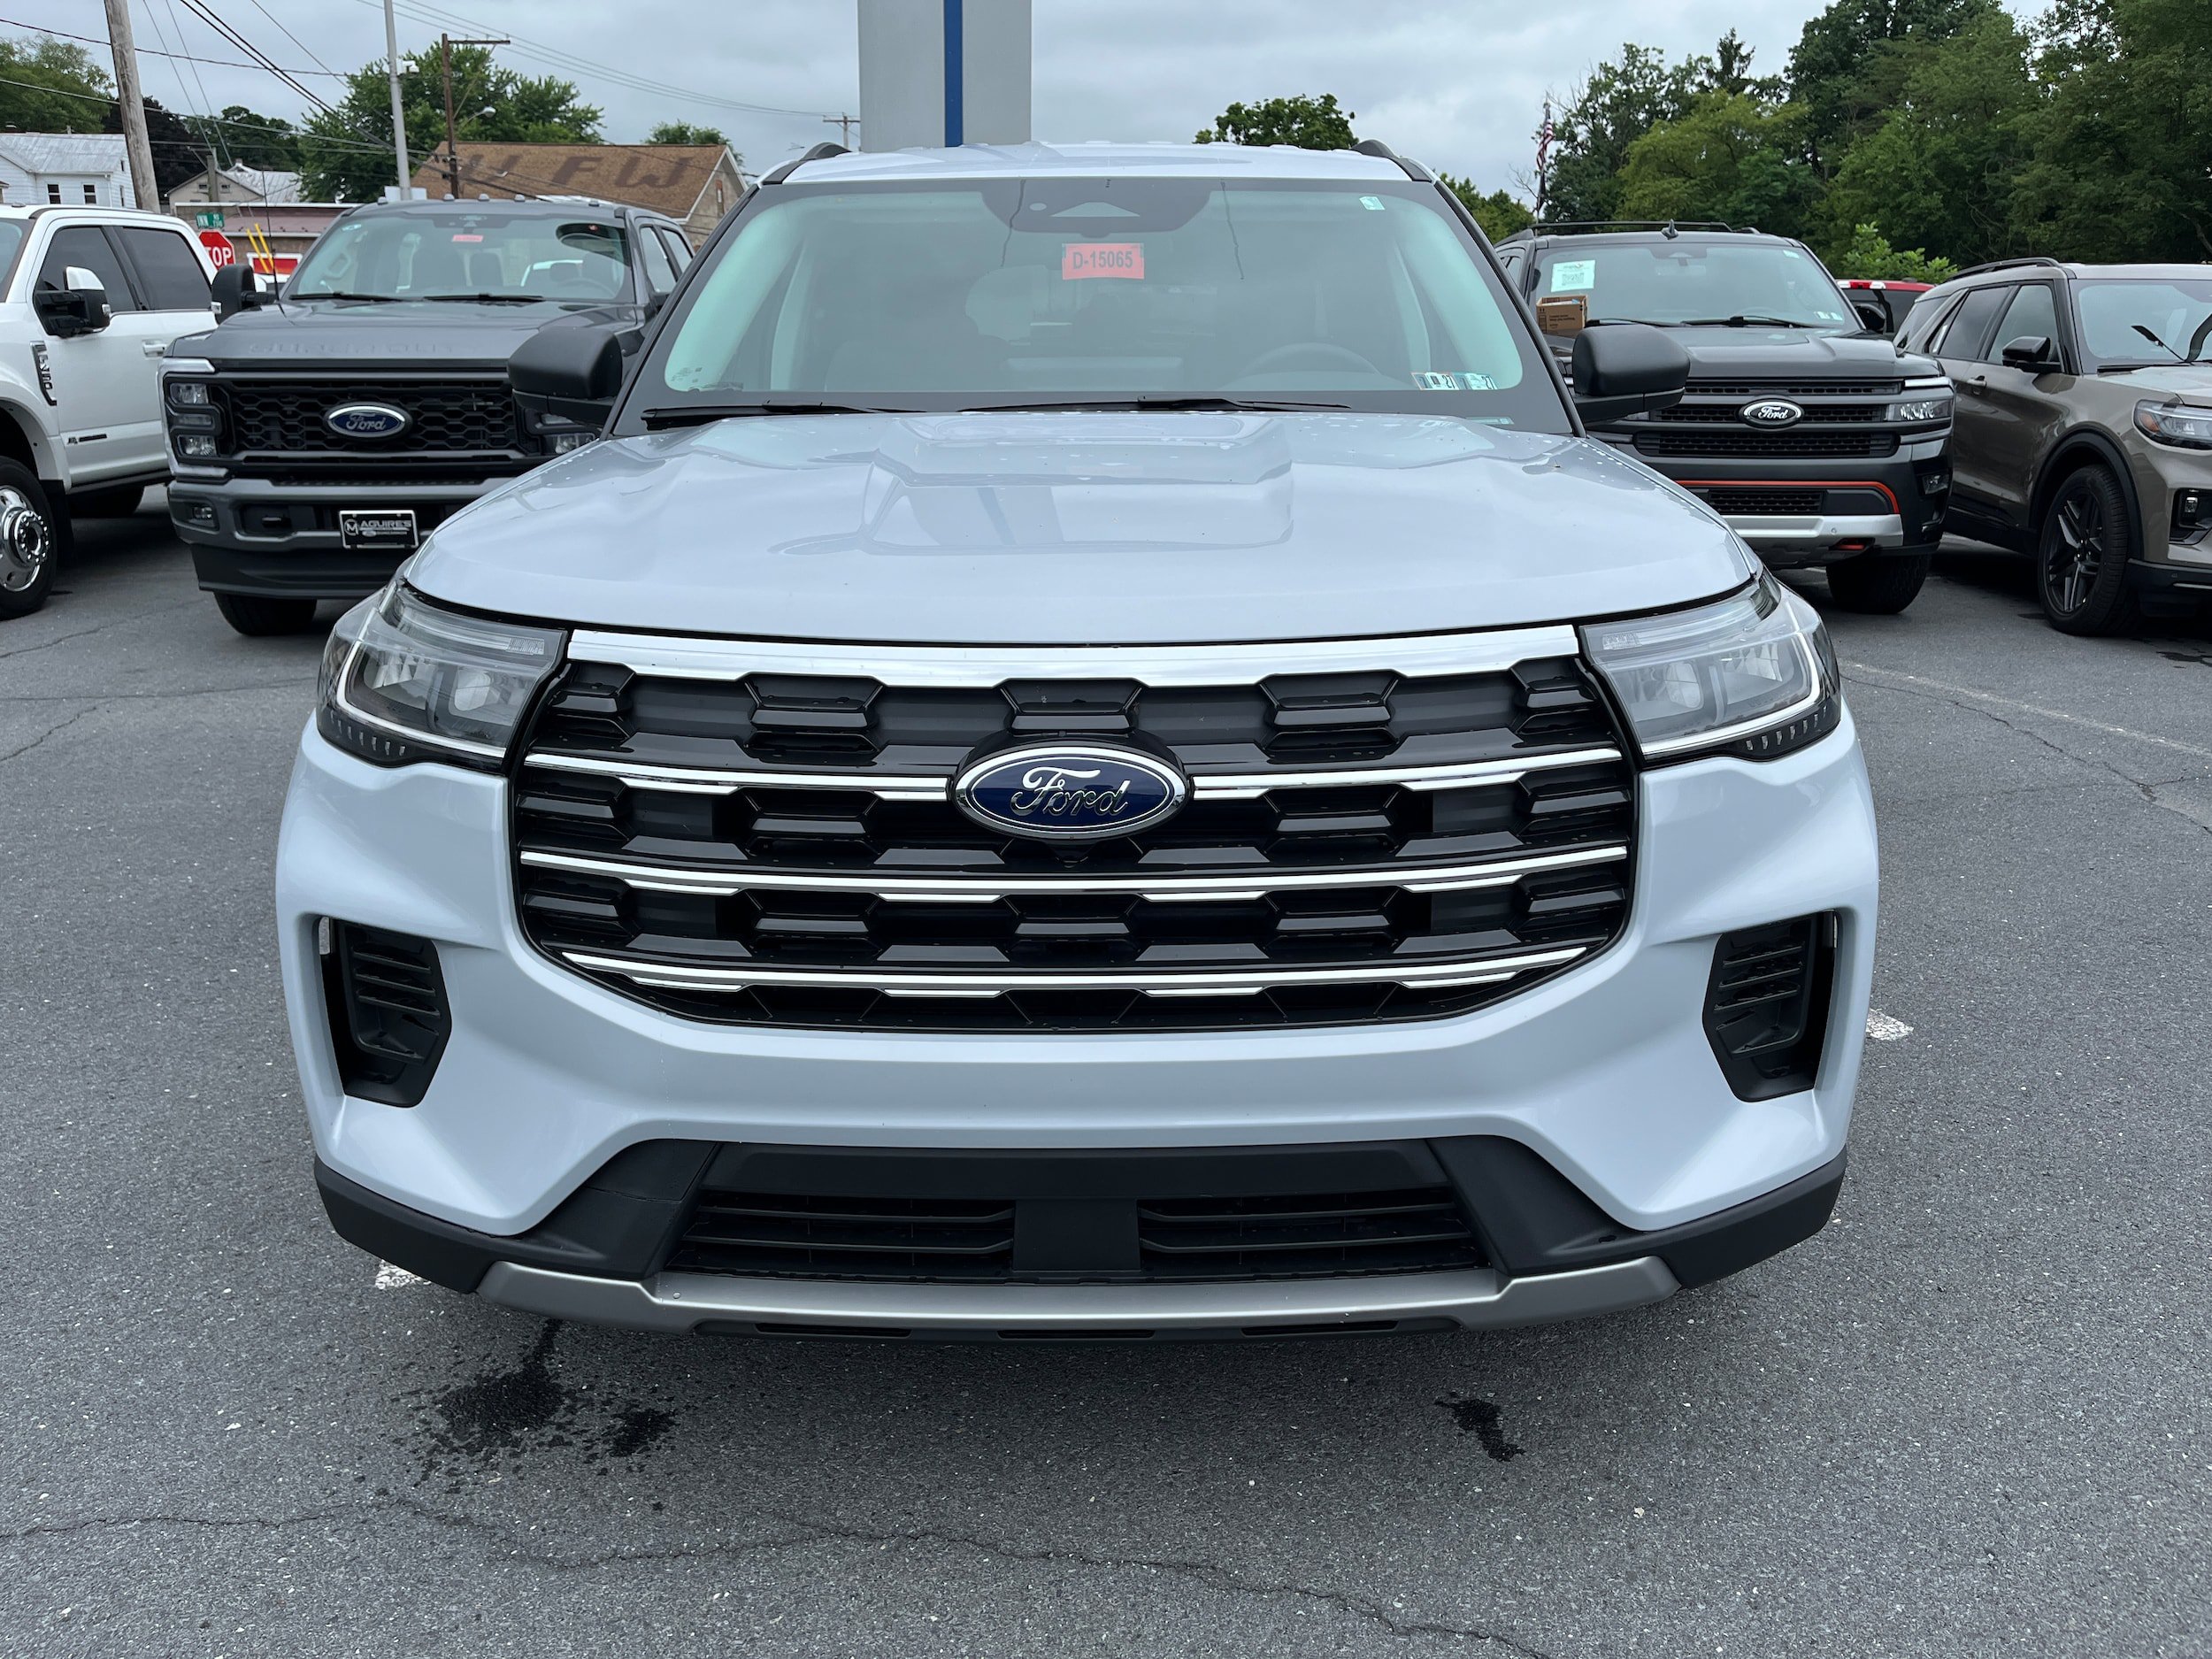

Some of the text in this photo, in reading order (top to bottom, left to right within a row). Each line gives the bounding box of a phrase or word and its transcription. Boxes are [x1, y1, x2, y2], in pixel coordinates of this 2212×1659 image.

[1072, 250, 1133, 269] D-15065
[345, 412, 387, 431] Ford
[1757, 406, 1789, 419] Ford
[1010, 765, 1132, 817] Ford
